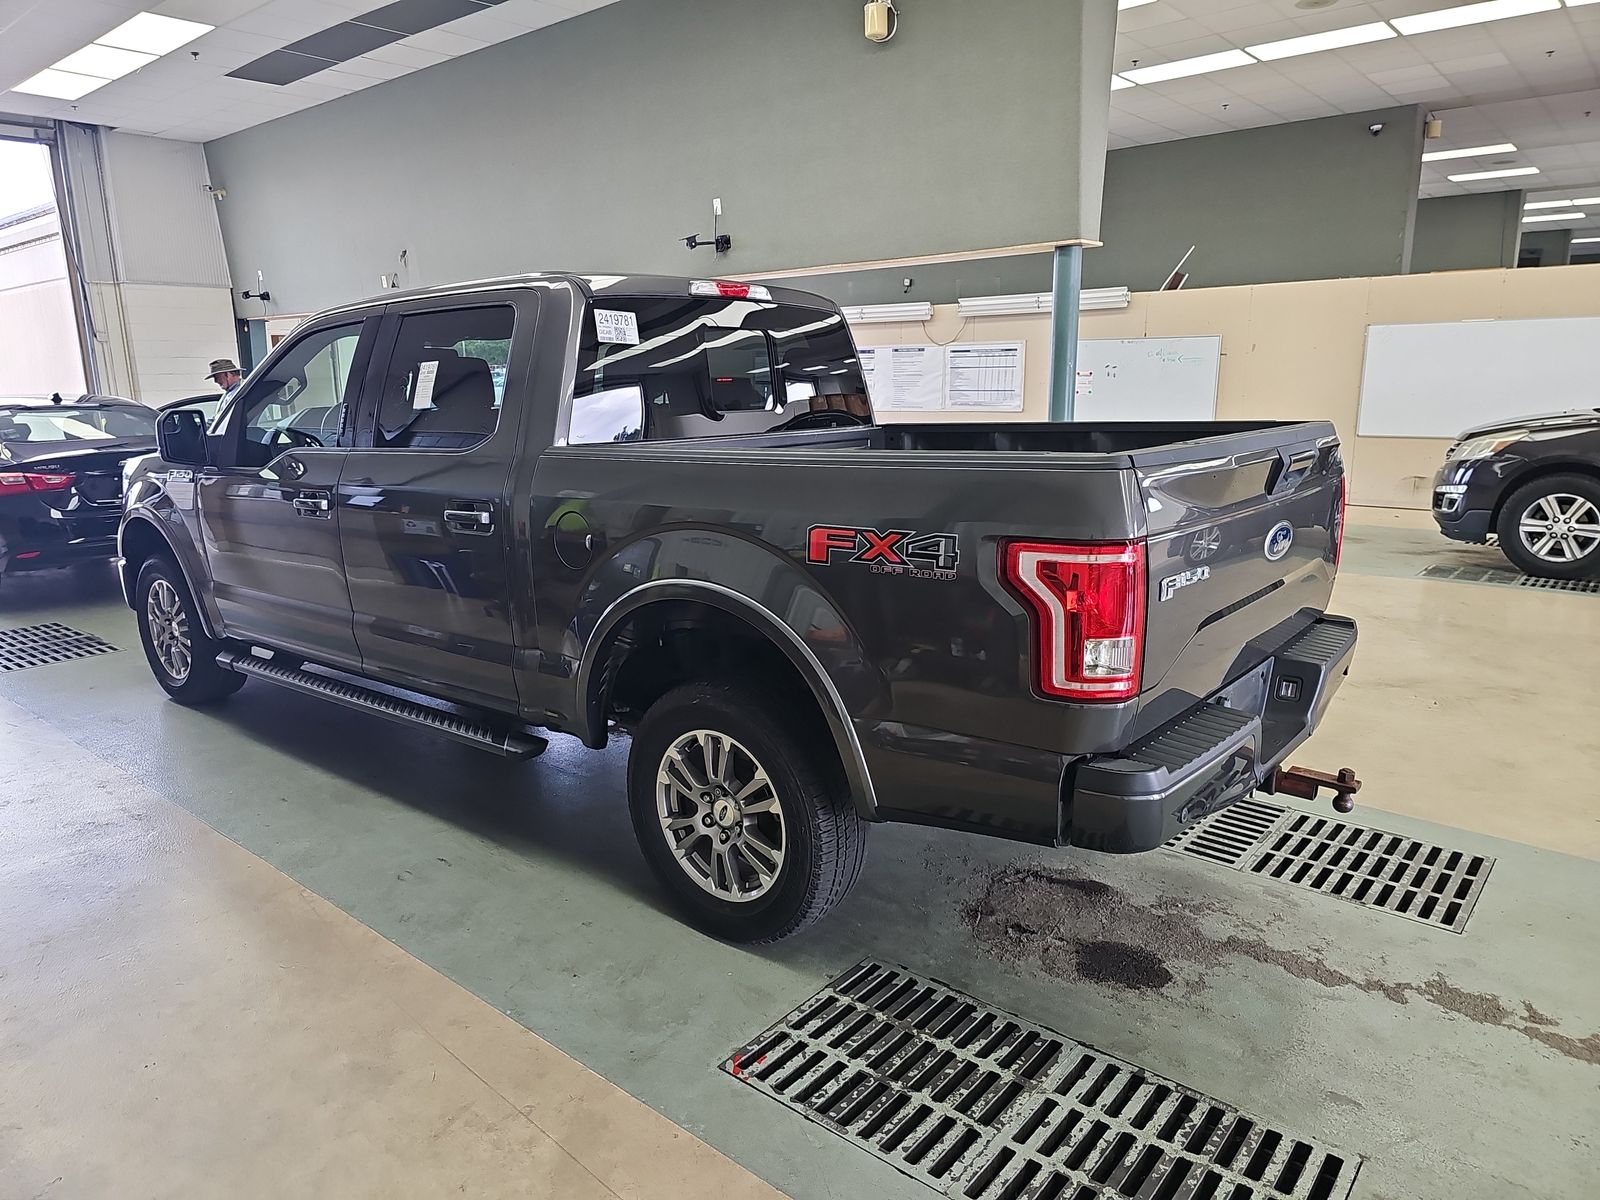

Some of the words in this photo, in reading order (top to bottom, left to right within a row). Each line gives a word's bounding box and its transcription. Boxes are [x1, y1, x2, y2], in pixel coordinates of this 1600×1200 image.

[598, 313, 633, 327] 2419781
[806, 523, 960, 572] FX4
[870, 565, 904, 575] OFF
[909, 568, 957, 580] ROAD
